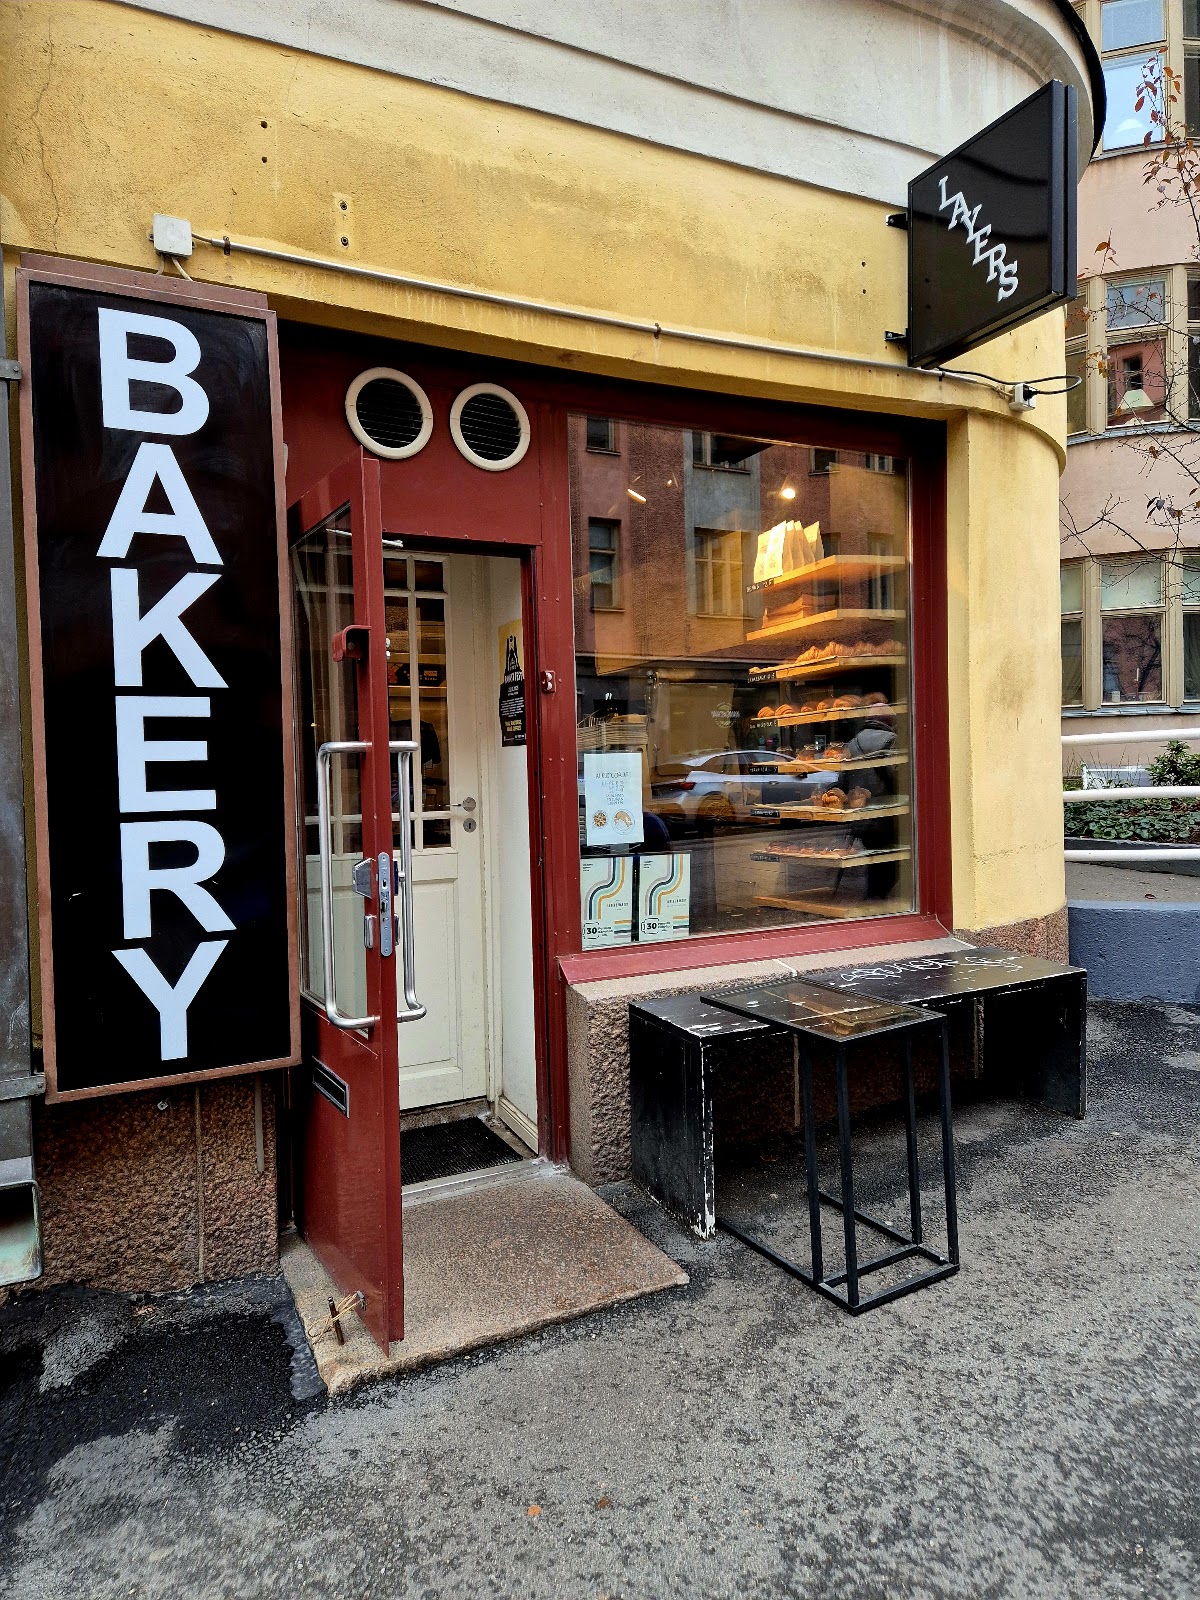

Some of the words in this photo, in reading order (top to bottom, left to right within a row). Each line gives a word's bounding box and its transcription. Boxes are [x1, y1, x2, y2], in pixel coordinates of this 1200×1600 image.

[938, 175, 1019, 303] LAYERS
[96, 306, 236, 1061] BAKERY
[586, 927, 597, 935] 30
[646, 922, 657, 930] 30
